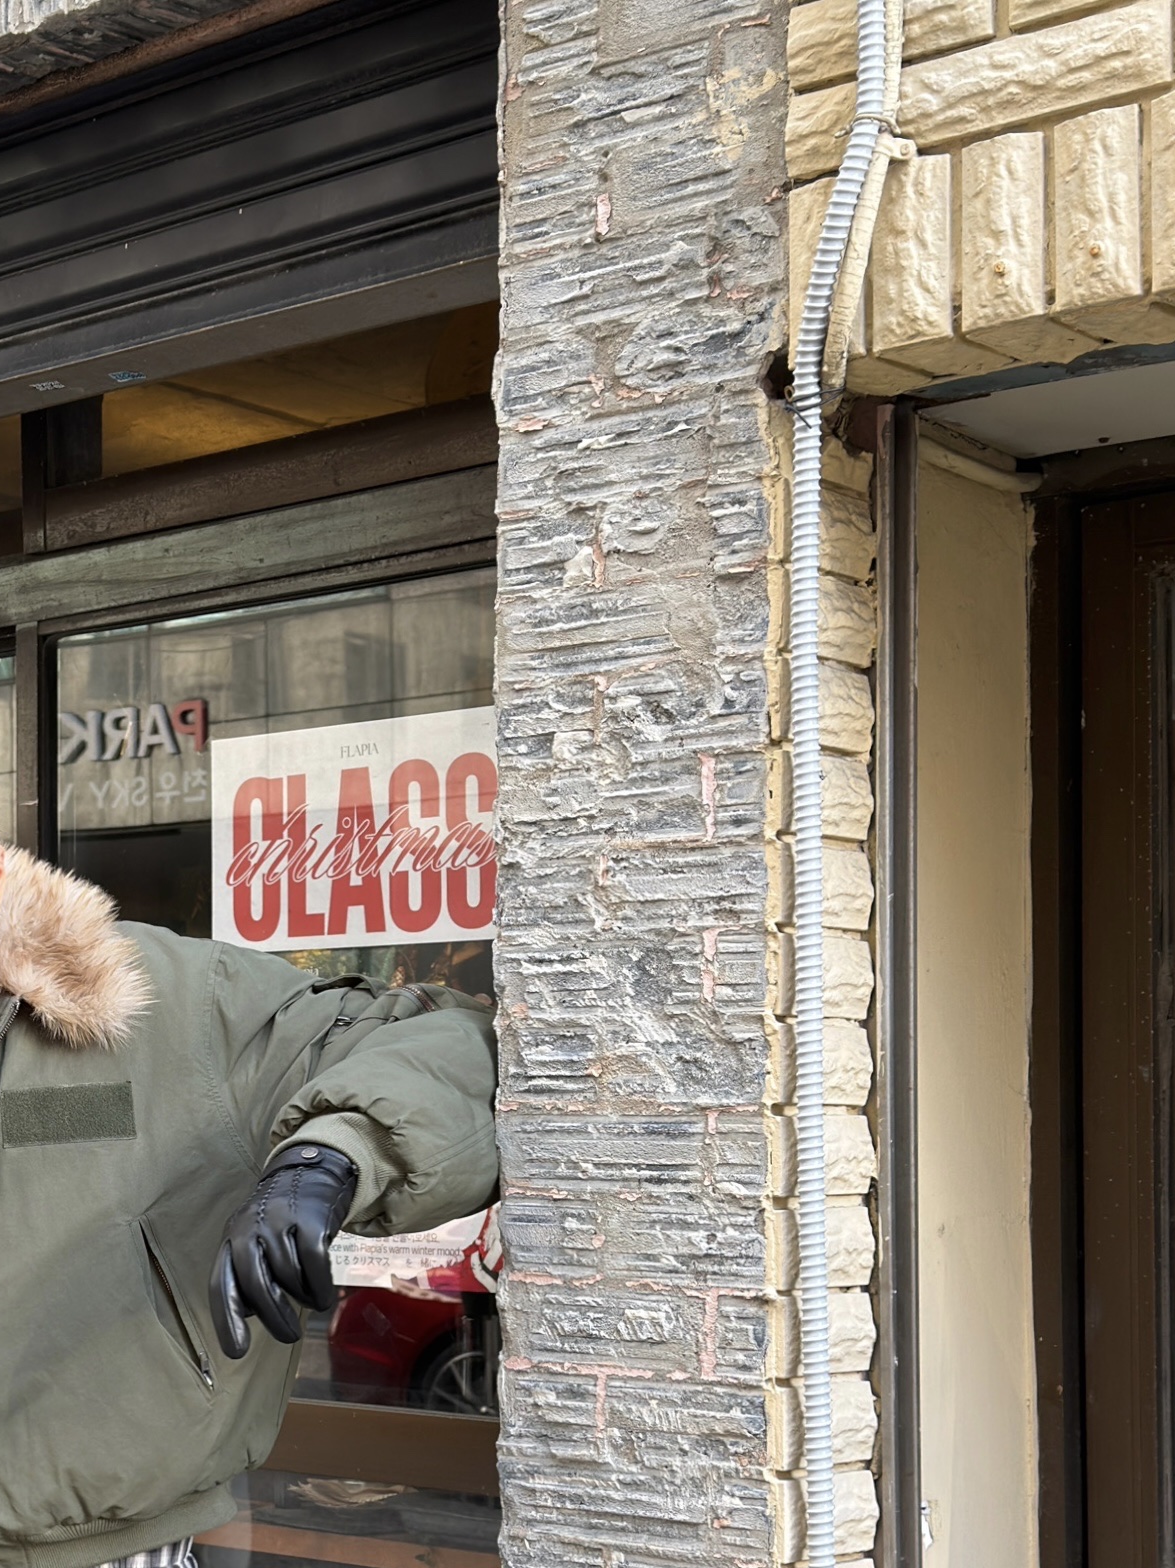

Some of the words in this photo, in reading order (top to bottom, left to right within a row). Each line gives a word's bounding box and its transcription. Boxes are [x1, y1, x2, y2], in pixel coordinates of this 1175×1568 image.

[340, 743, 379, 759] FLAPIA
[226, 803, 498, 887] christmas
[343, 1243, 359, 1252] with
[388, 1246, 410, 1255] warm
[411, 1245, 436, 1256] winter
